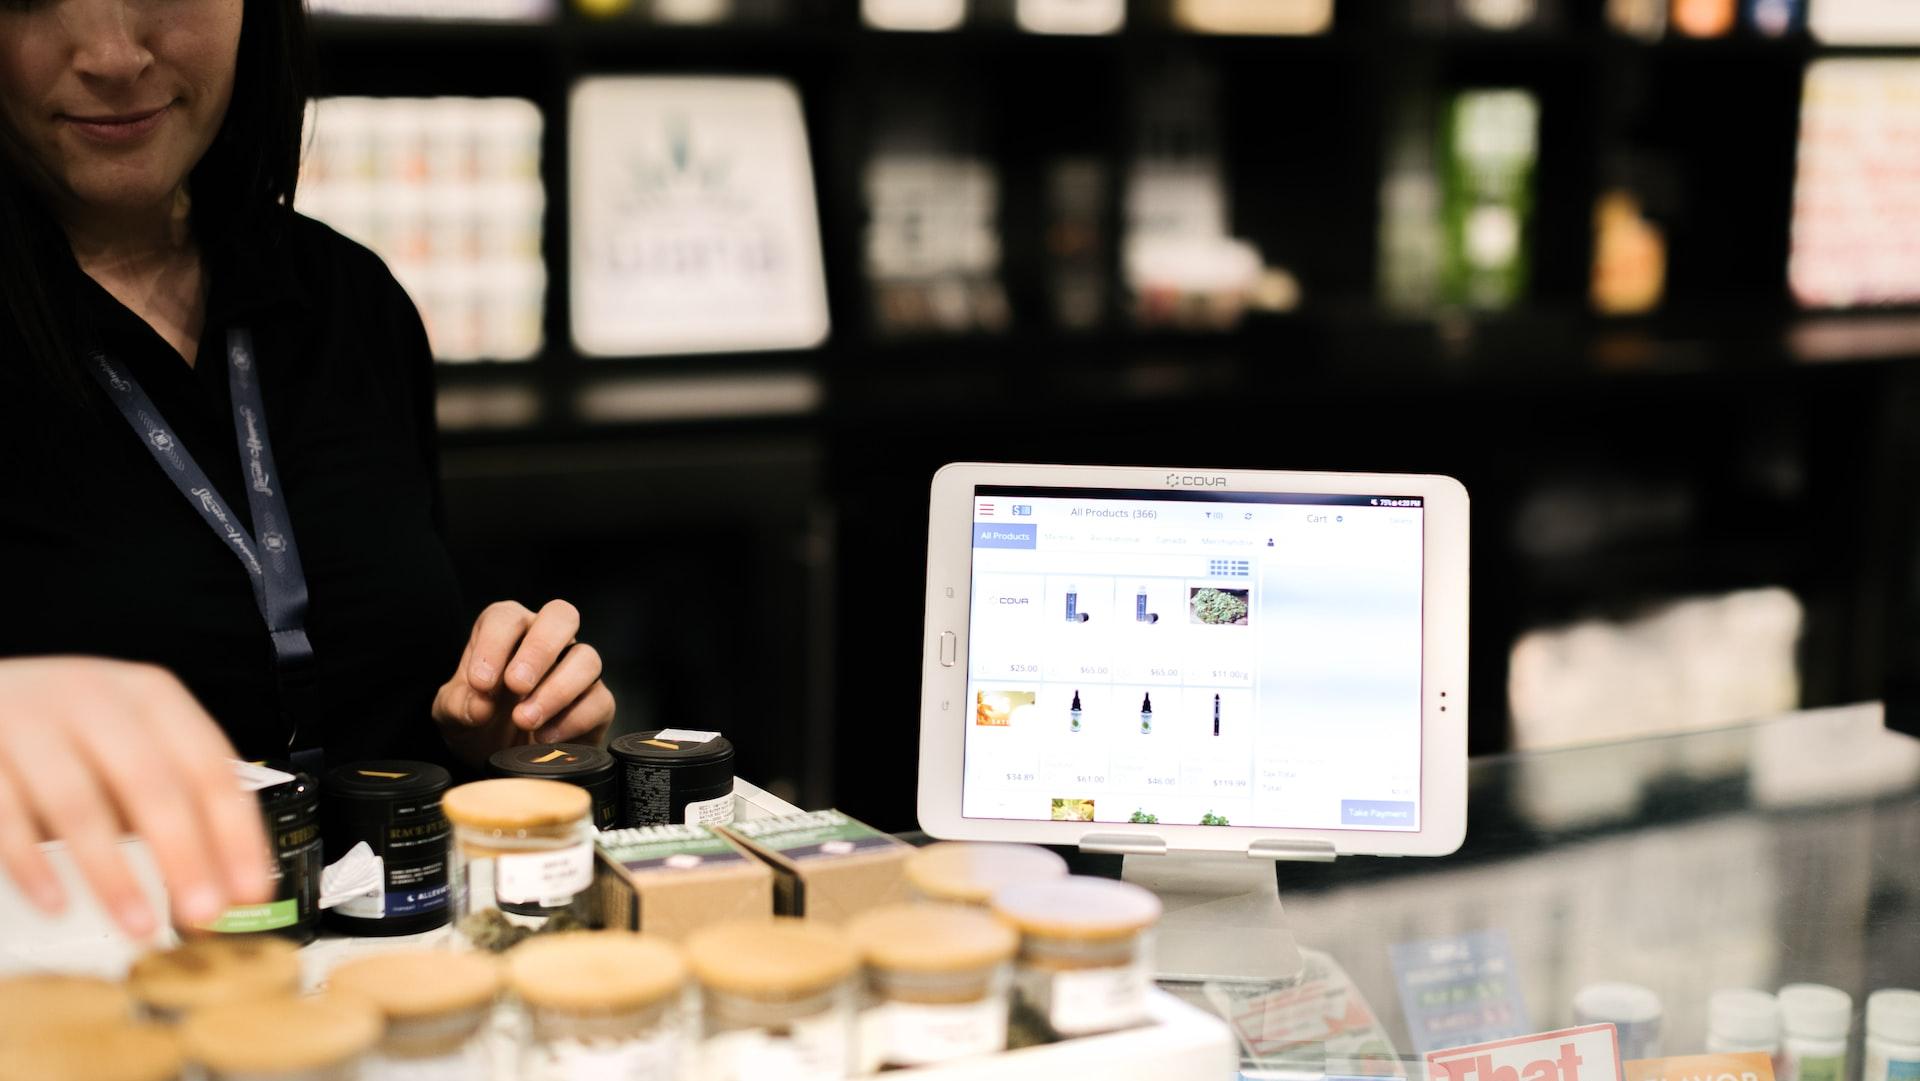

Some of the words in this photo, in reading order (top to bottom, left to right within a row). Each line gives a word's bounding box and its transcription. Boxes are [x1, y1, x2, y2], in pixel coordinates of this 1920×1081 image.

[1181, 476, 1227, 487] COVA
[1070, 507, 1084, 517] All
[1086, 507, 1129, 518] Products
[1132, 508, 1157, 520] (366)
[1306, 514, 1328, 524] Cart
[981, 531, 993, 540] All
[994, 531, 1030, 541] Products
[999, 597, 1029, 605] COVA
[1010, 663, 1038, 673] $25.00
[1080, 665, 1108, 675] $65.00
[1150, 667, 1178, 677] $65.00
[1348, 807, 1369, 818] Take
[1370, 808, 1408, 820] Payment
